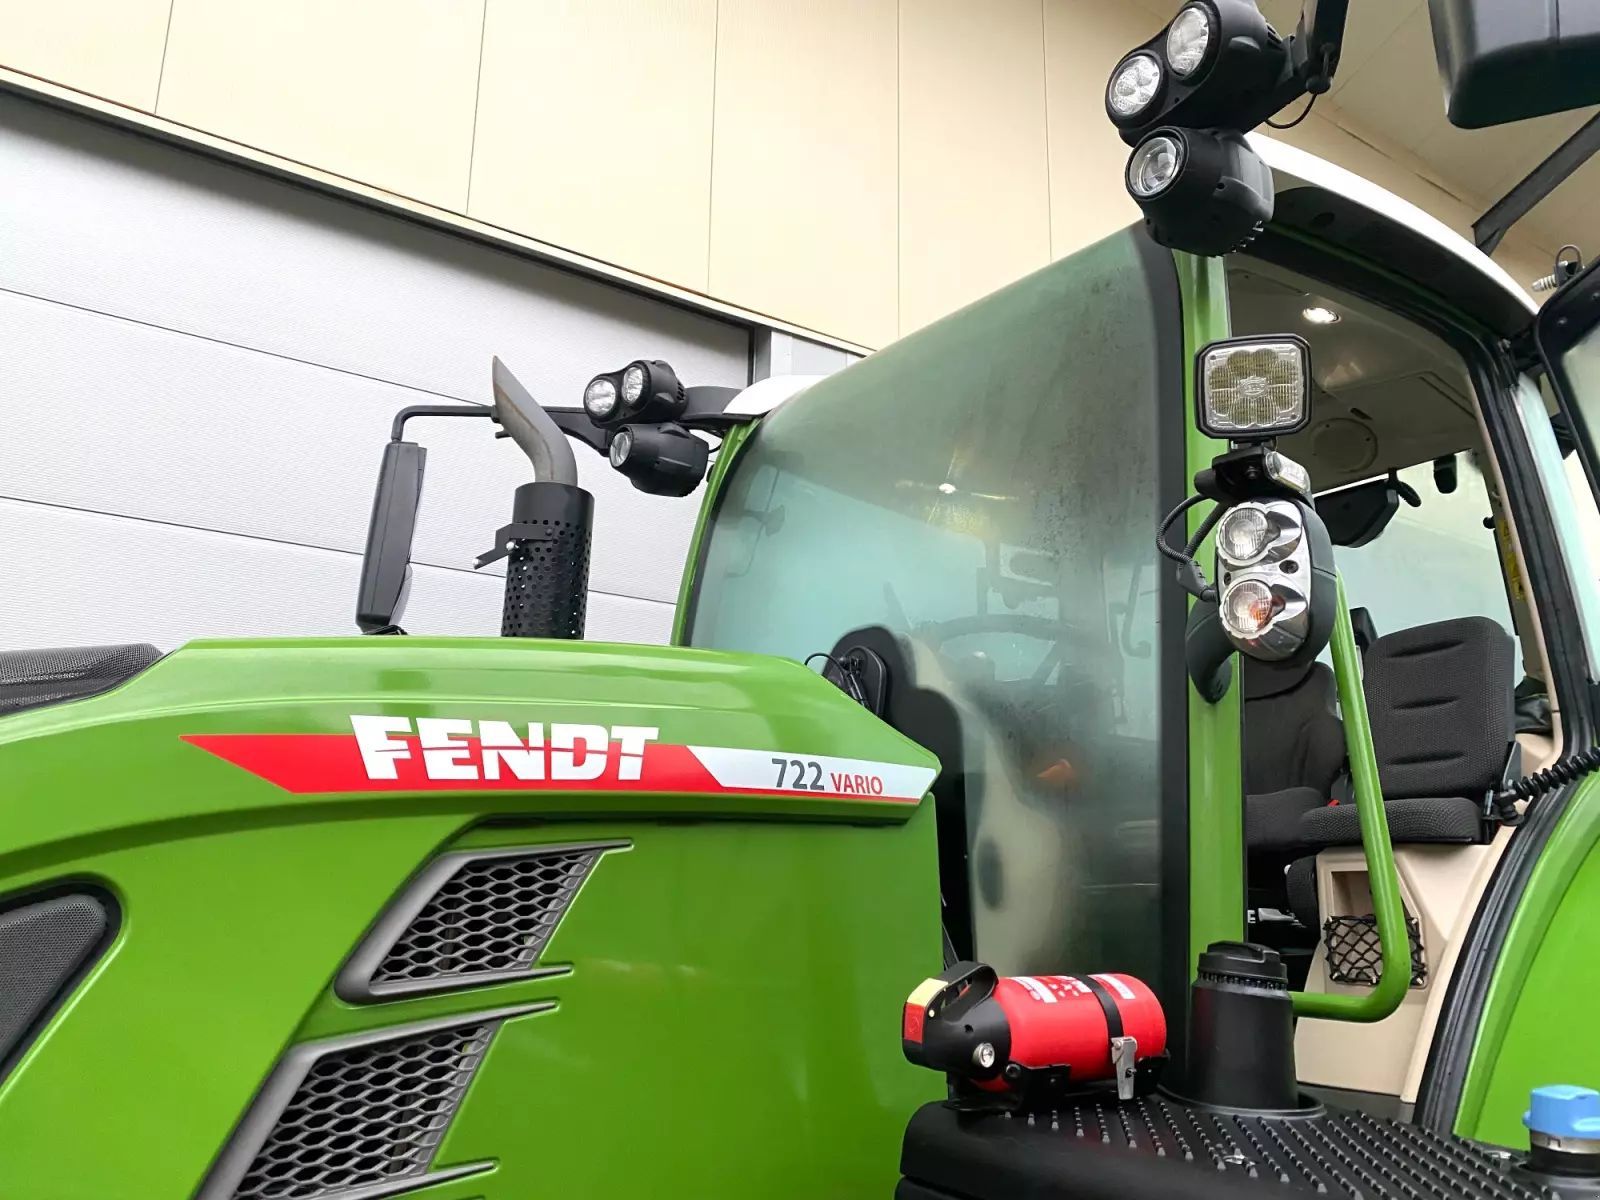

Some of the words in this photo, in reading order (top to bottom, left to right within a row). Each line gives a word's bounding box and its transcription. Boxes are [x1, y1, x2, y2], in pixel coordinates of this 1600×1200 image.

[349, 715, 660, 780] FENDT
[771, 758, 825, 791] 722
[830, 772, 883, 795] VARIO
